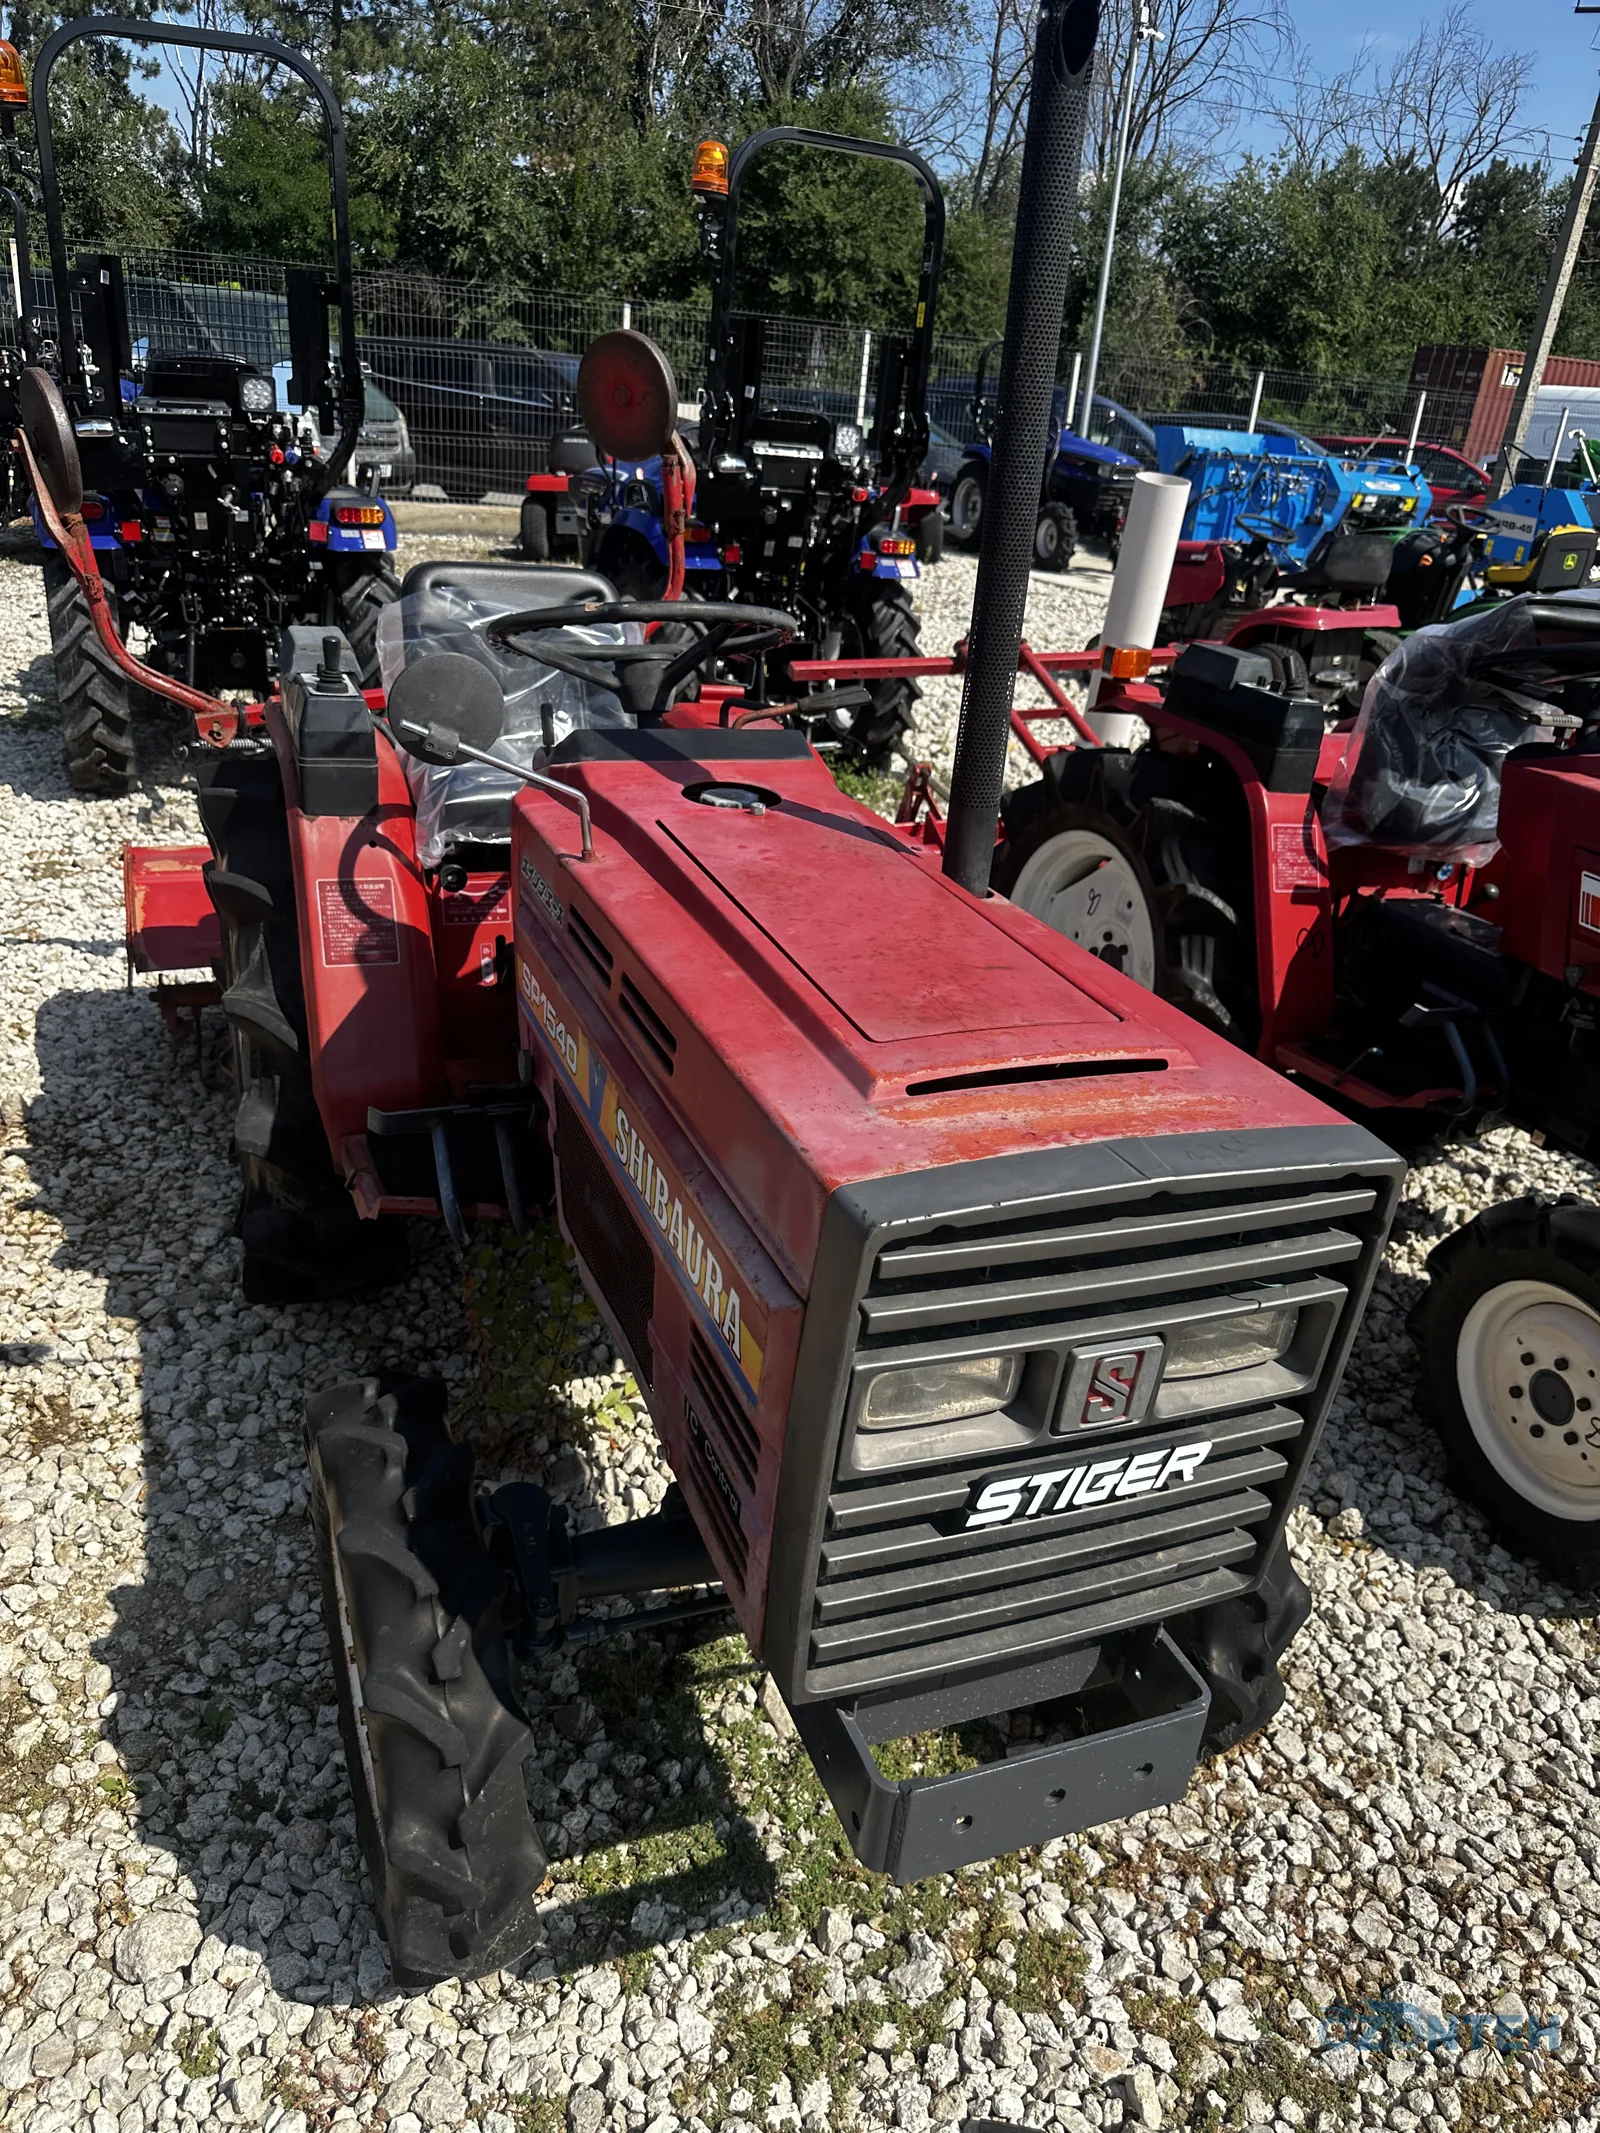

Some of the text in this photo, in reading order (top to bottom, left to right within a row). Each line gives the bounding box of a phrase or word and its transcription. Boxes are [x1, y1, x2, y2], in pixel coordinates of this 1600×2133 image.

[522, 961, 577, 1076] SP1540
[614, 1107, 742, 1361] SHIBAURA
[704, 1439, 738, 1517] Control
[965, 1440, 1213, 1527] STIGER
